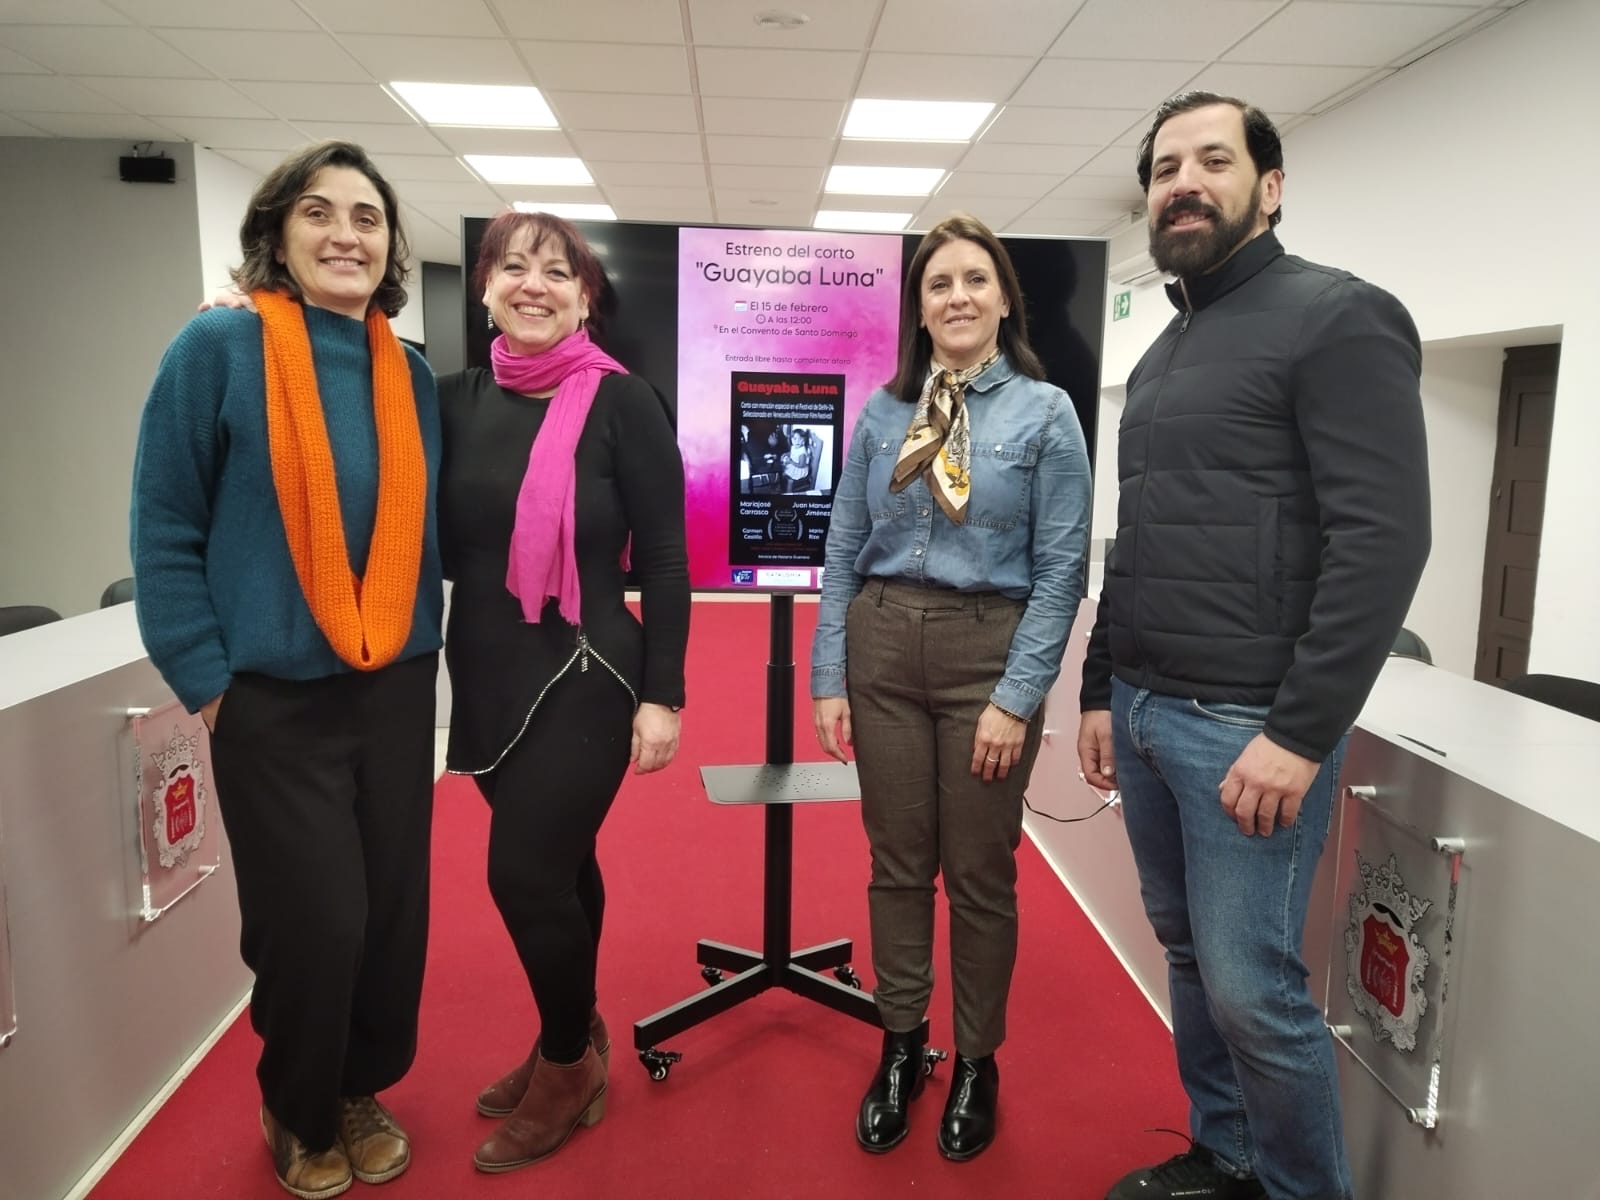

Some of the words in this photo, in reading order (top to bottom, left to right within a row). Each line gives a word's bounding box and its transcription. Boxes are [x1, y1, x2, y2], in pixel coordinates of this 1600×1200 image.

[726, 242, 782, 258] Estreno
[787, 245, 810, 258] del
[814, 248, 855, 260] corto
[696, 261, 812, 288] "Guayaba
[819, 266, 884, 287] Luna"
[750, 302, 759, 311] El
[761, 302, 771, 311] 15
[774, 302, 787, 312] de
[790, 302, 829, 313] febrero
[776, 315, 788, 324] las
[790, 316, 812, 324] 12:00
[719, 326, 729, 334] En
[731, 326, 739, 334] el
[740, 327, 780, 335] Convento
[782, 327, 793, 336] de
[794, 328, 819, 336] Santo
[820, 329, 858, 338] Domingo
[725, 354, 754, 363] Entrada
[755, 355, 771, 363] libre
[772, 355, 793, 363] hasta
[794, 356, 830, 366] completar
[832, 357, 851, 365] aforo
[737, 381, 800, 395] Guayaba
[803, 383, 838, 395] Luna
[740, 501, 771, 509] Mariajosé
[740, 508, 769, 516] Carrasco
[805, 509, 831, 517] Jiménez
